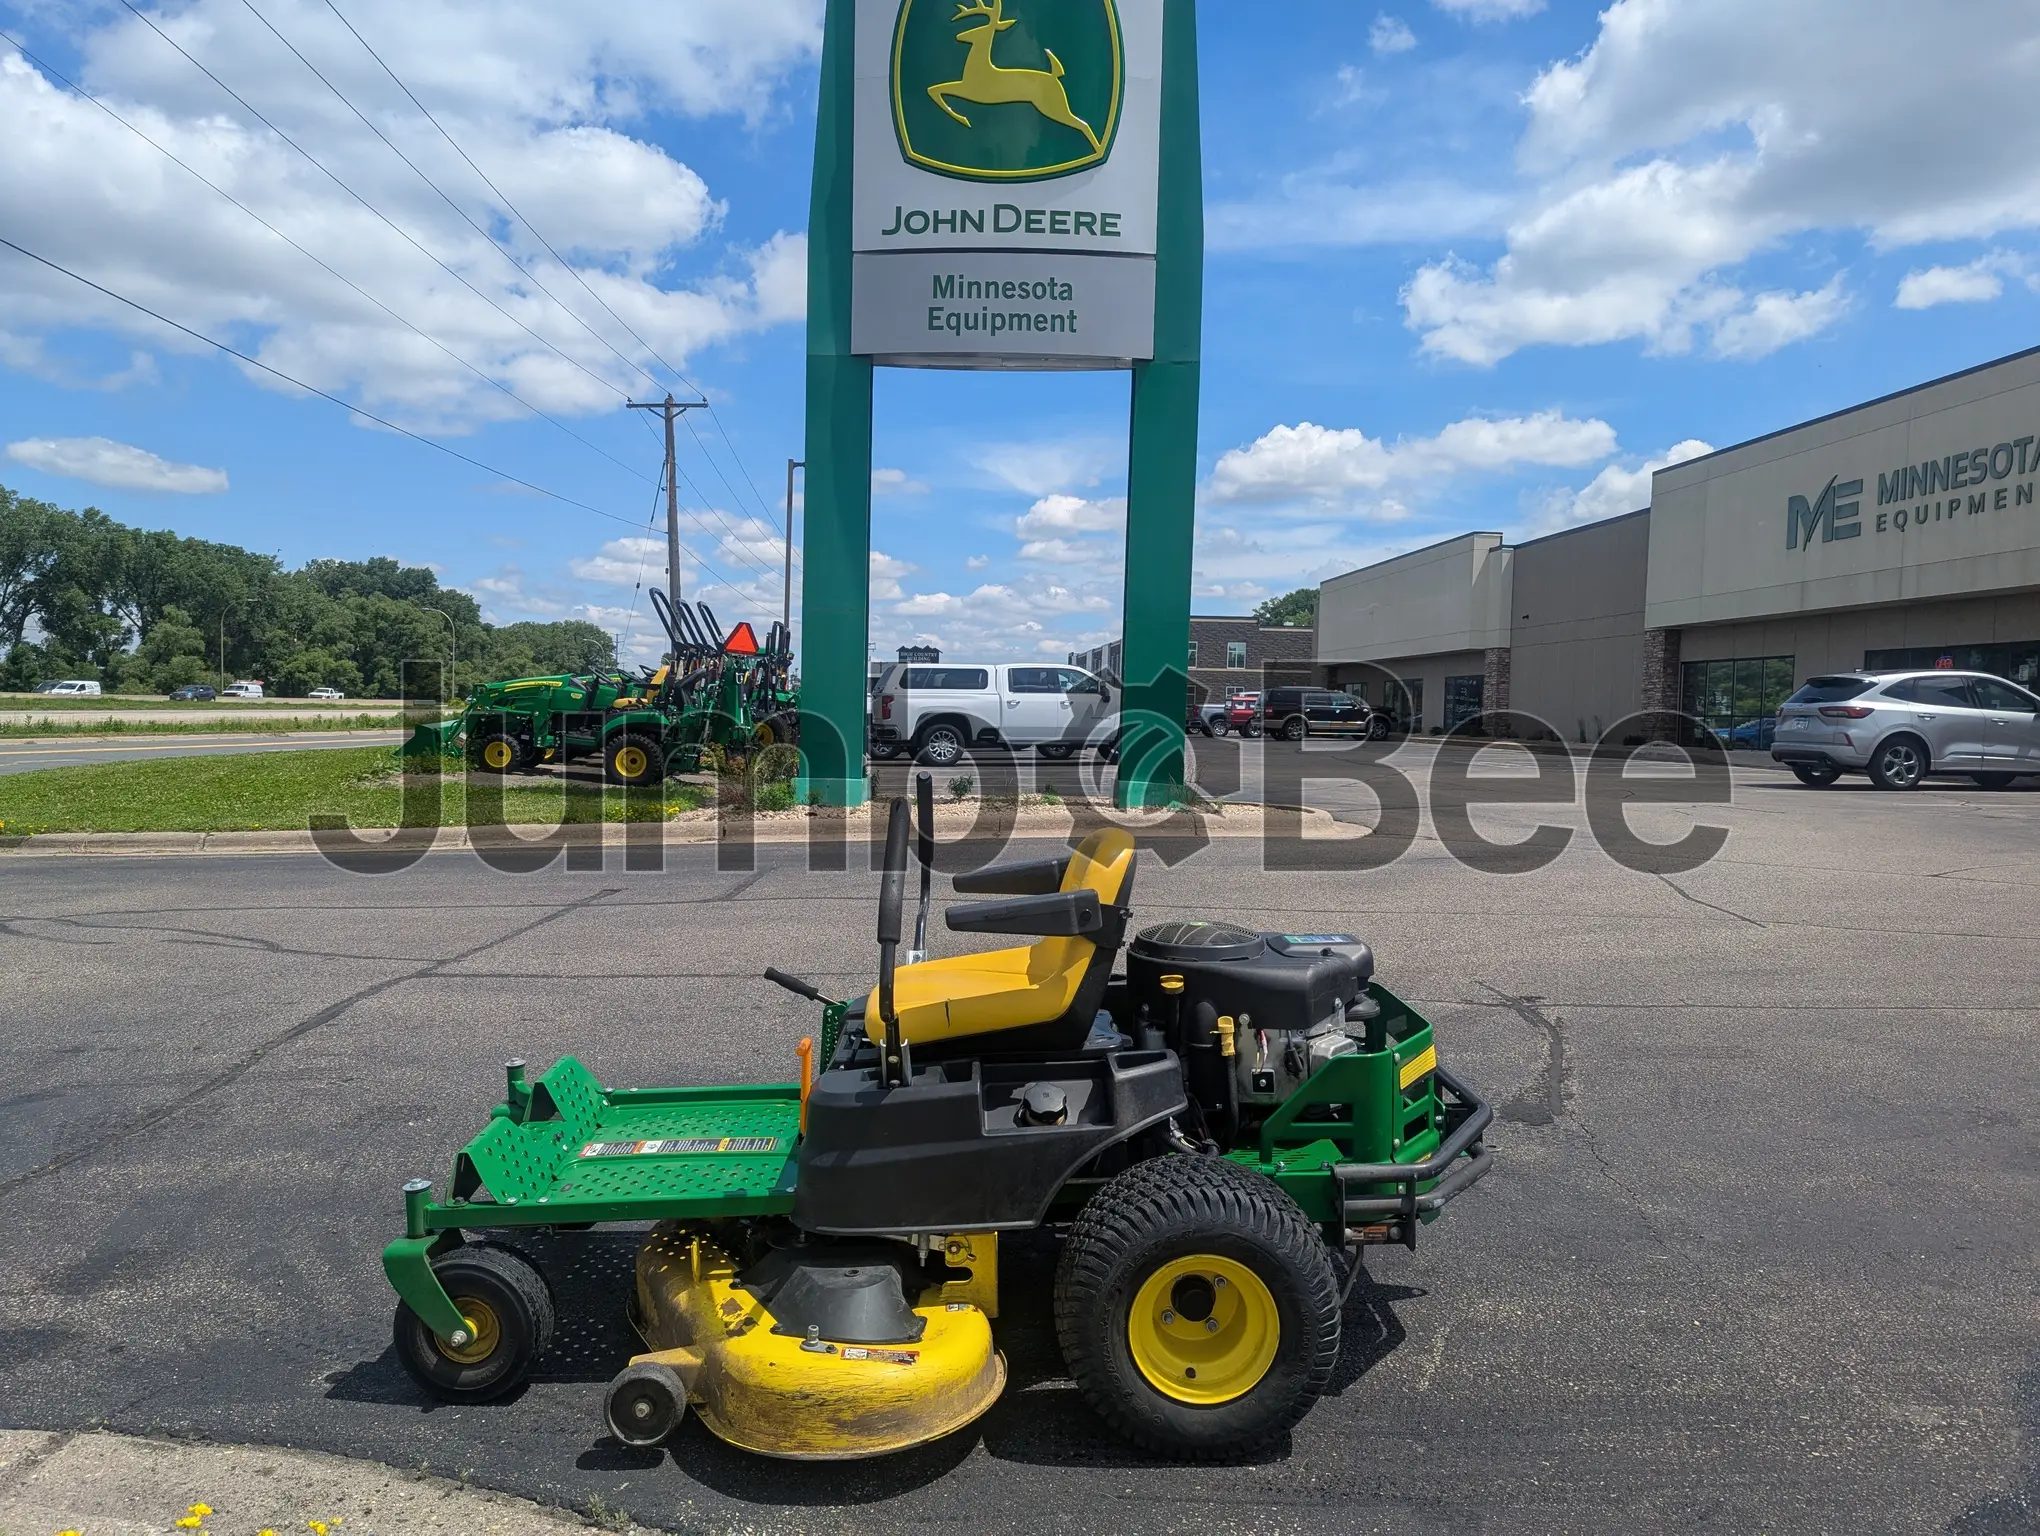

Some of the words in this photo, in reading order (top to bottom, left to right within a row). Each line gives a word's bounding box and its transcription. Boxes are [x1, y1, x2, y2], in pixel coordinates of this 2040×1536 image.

[882, 205, 985, 236] JOHN
[993, 203, 1122, 237] DEERE
[932, 274, 1073, 301] Minnesota
[928, 306, 1077, 336] Equipment
